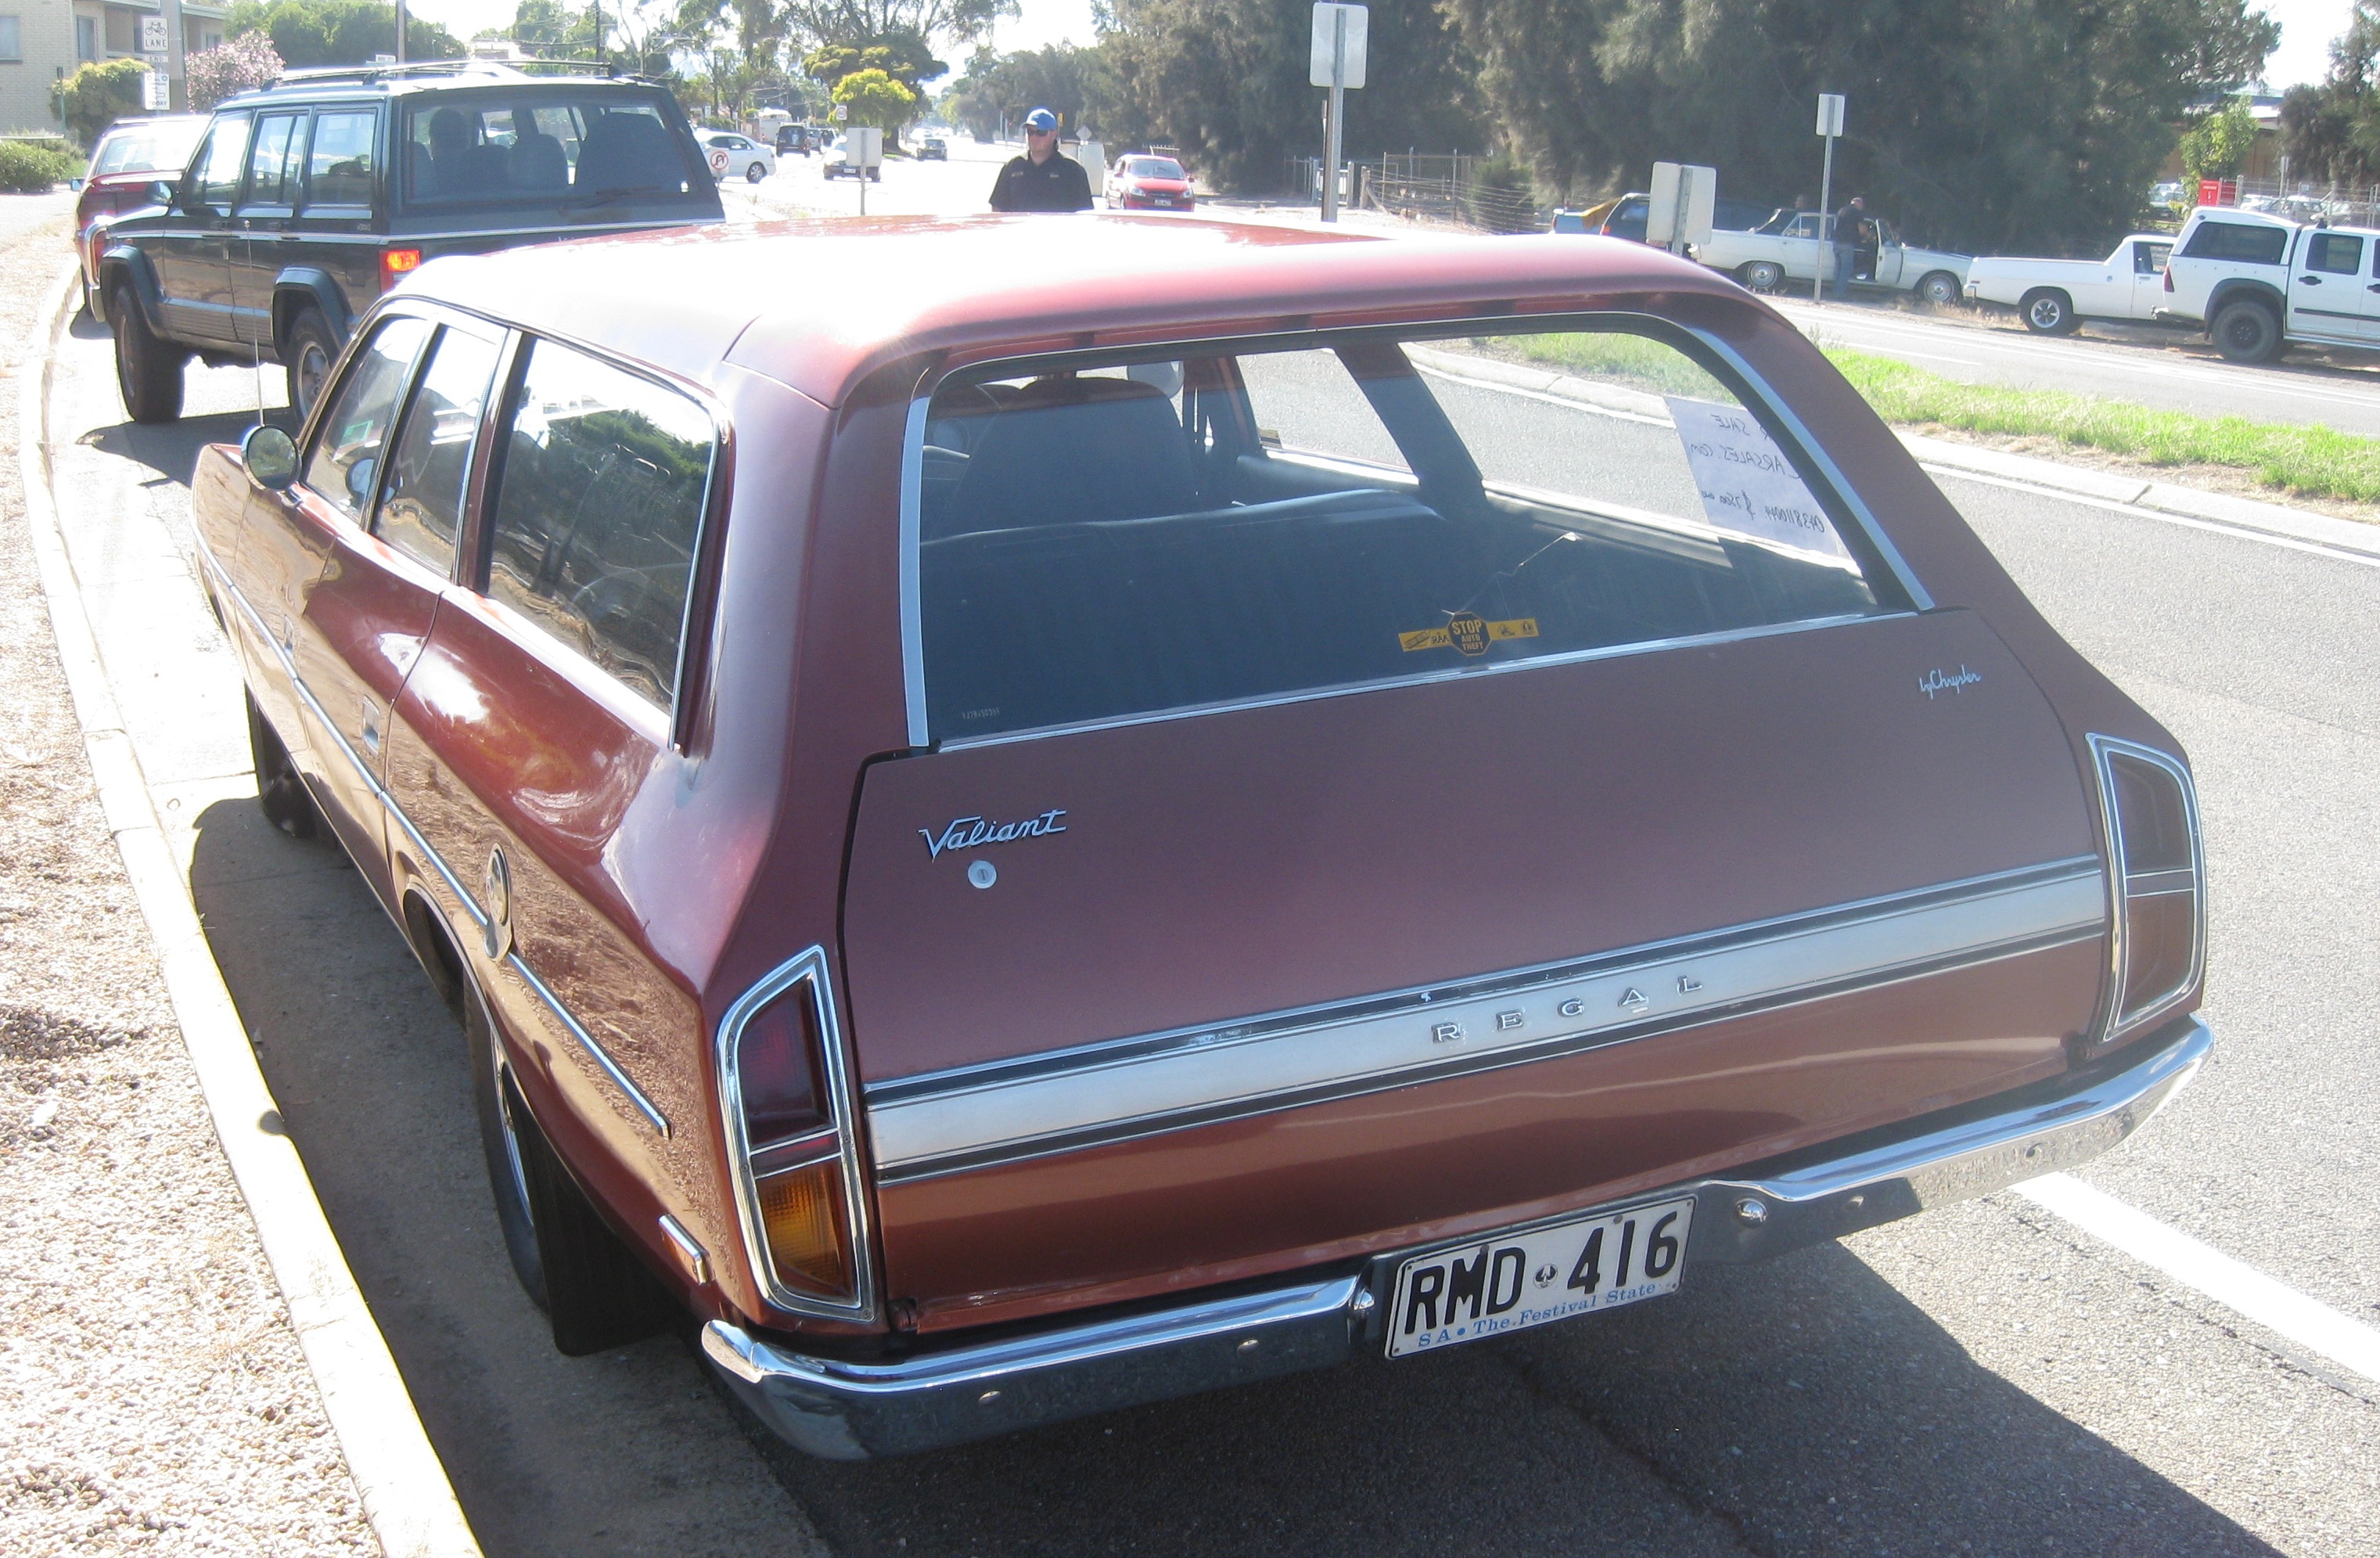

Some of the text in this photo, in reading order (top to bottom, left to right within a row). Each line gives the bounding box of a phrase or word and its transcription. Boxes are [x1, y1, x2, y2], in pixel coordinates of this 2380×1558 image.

[1451, 619, 1483, 635] STOP
[1461, 634, 1481, 642] AUTO
[1462, 642, 1483, 650] THEFT
[1929, 664, 1982, 694] Chrysler
[917, 809, 1067, 863] Valiant
[1433, 975, 1703, 1043] REGAL
[1404, 1211, 1679, 1335] RMD 416
[1472, 1317, 1511, 1335] The
[1519, 1297, 1597, 1325] Festival
[1605, 1283, 1656, 1305] State
